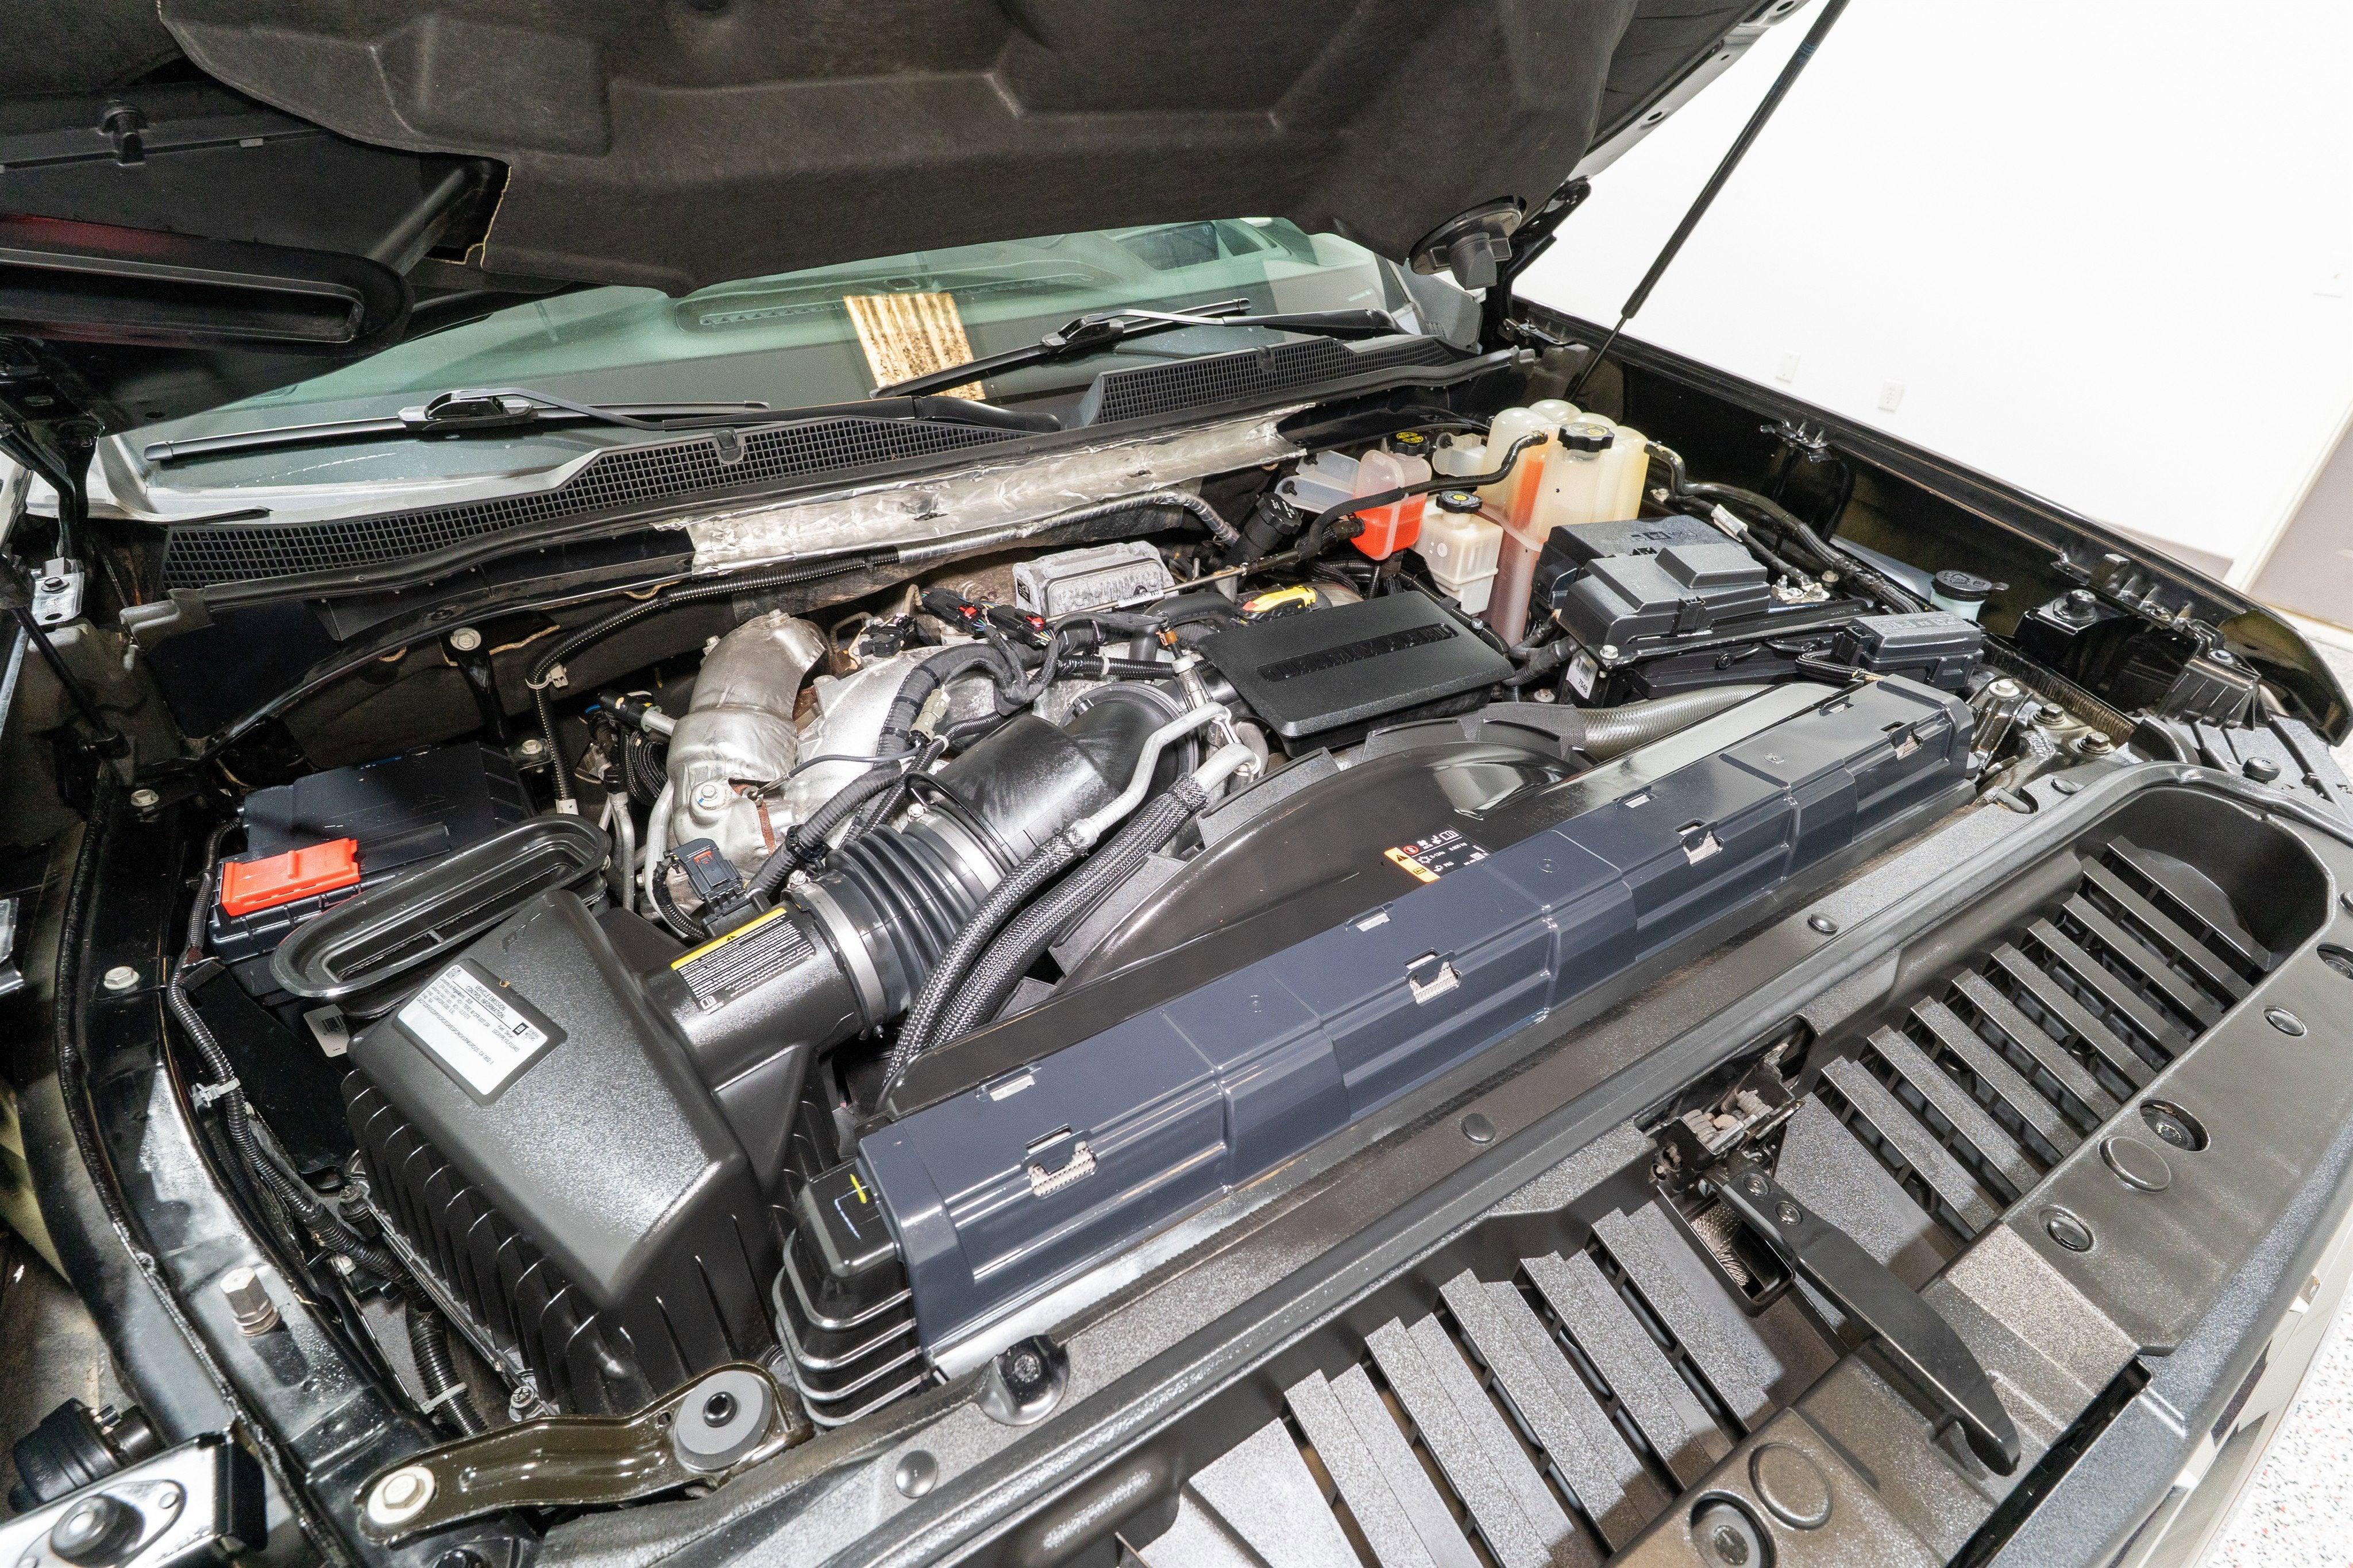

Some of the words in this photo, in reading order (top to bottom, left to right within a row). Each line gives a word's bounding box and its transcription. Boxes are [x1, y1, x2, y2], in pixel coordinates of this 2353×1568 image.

[1259, 640, 1378, 682] DURAMAX
[1579, 678, 1588, 693] 7548
[465, 986, 481, 1001] CONTROL
[480, 998, 505, 1018] INFORMATION
[475, 985, 491, 998] VEHICLE
[488, 996, 507, 1011] EMISSION
